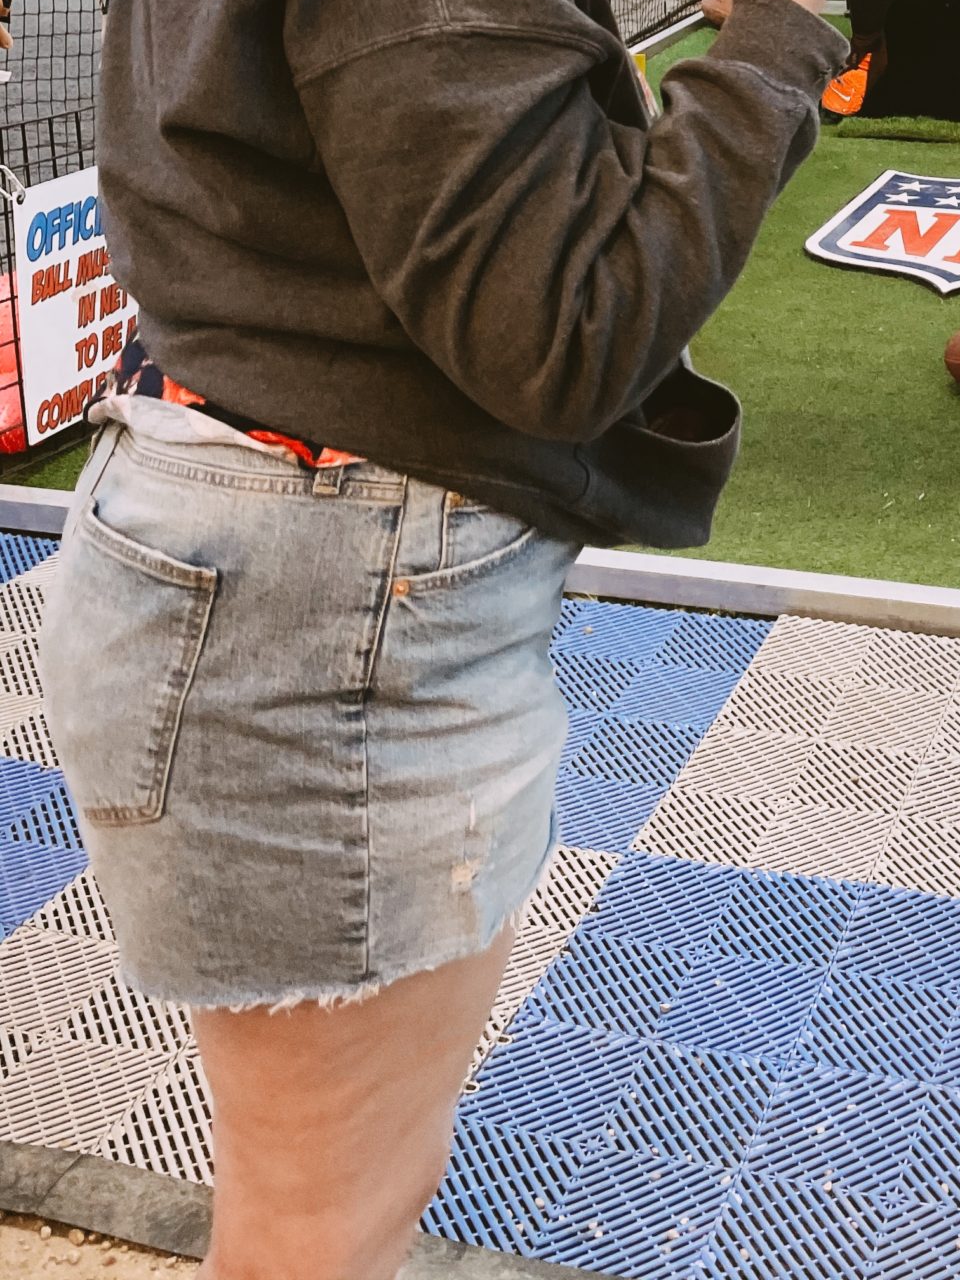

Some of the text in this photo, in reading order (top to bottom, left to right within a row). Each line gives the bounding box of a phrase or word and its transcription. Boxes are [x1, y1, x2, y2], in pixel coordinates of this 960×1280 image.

[31, 260, 73, 306] BALL
[78, 291, 96, 329] IN
[75, 332, 98, 372] TO
[102, 320, 123, 361] BE
